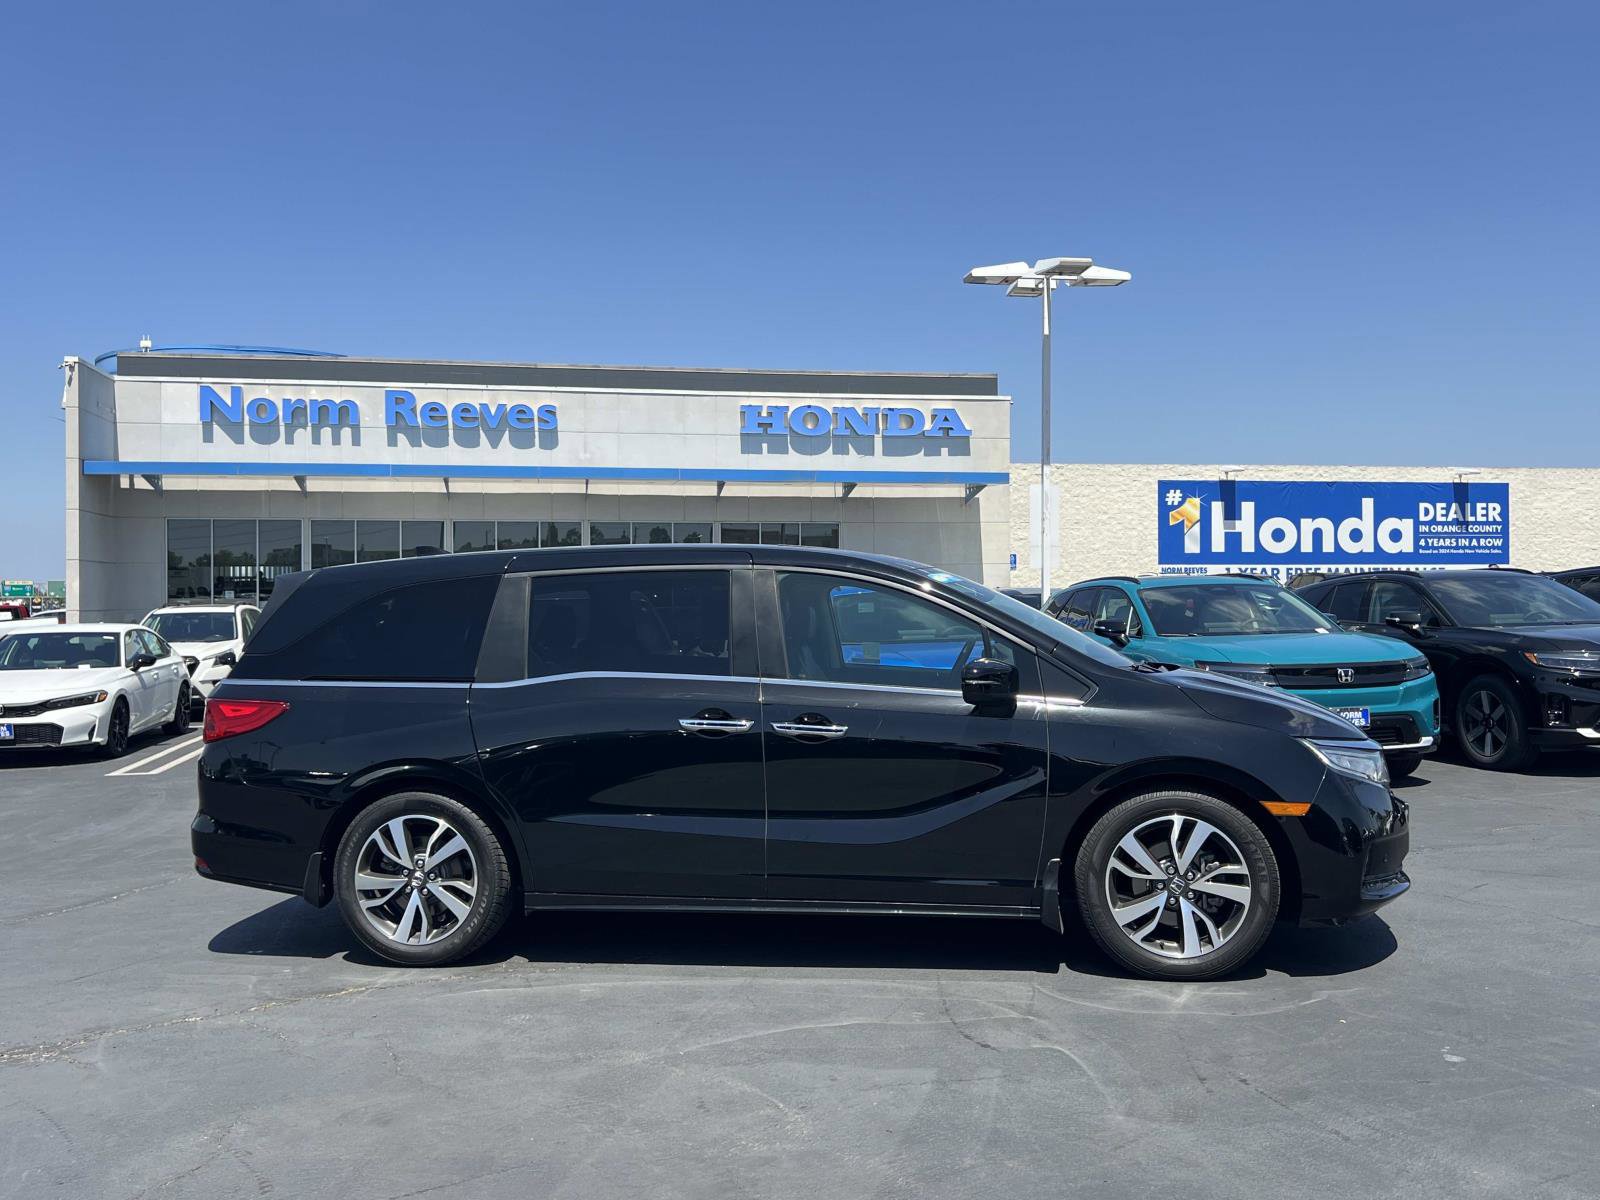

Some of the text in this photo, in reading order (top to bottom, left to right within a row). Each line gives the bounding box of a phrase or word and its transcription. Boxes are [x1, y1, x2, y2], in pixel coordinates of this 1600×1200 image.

[200, 385, 558, 430] Norm Reeves
[740, 405, 972, 437] HONDA
[1419, 502, 1502, 521] DEALER
[1211, 497, 1414, 553] Honda
[1419, 538, 1503, 546] 4 YEARS IN A ROW
[1161, 566, 1183, 574] NORM
